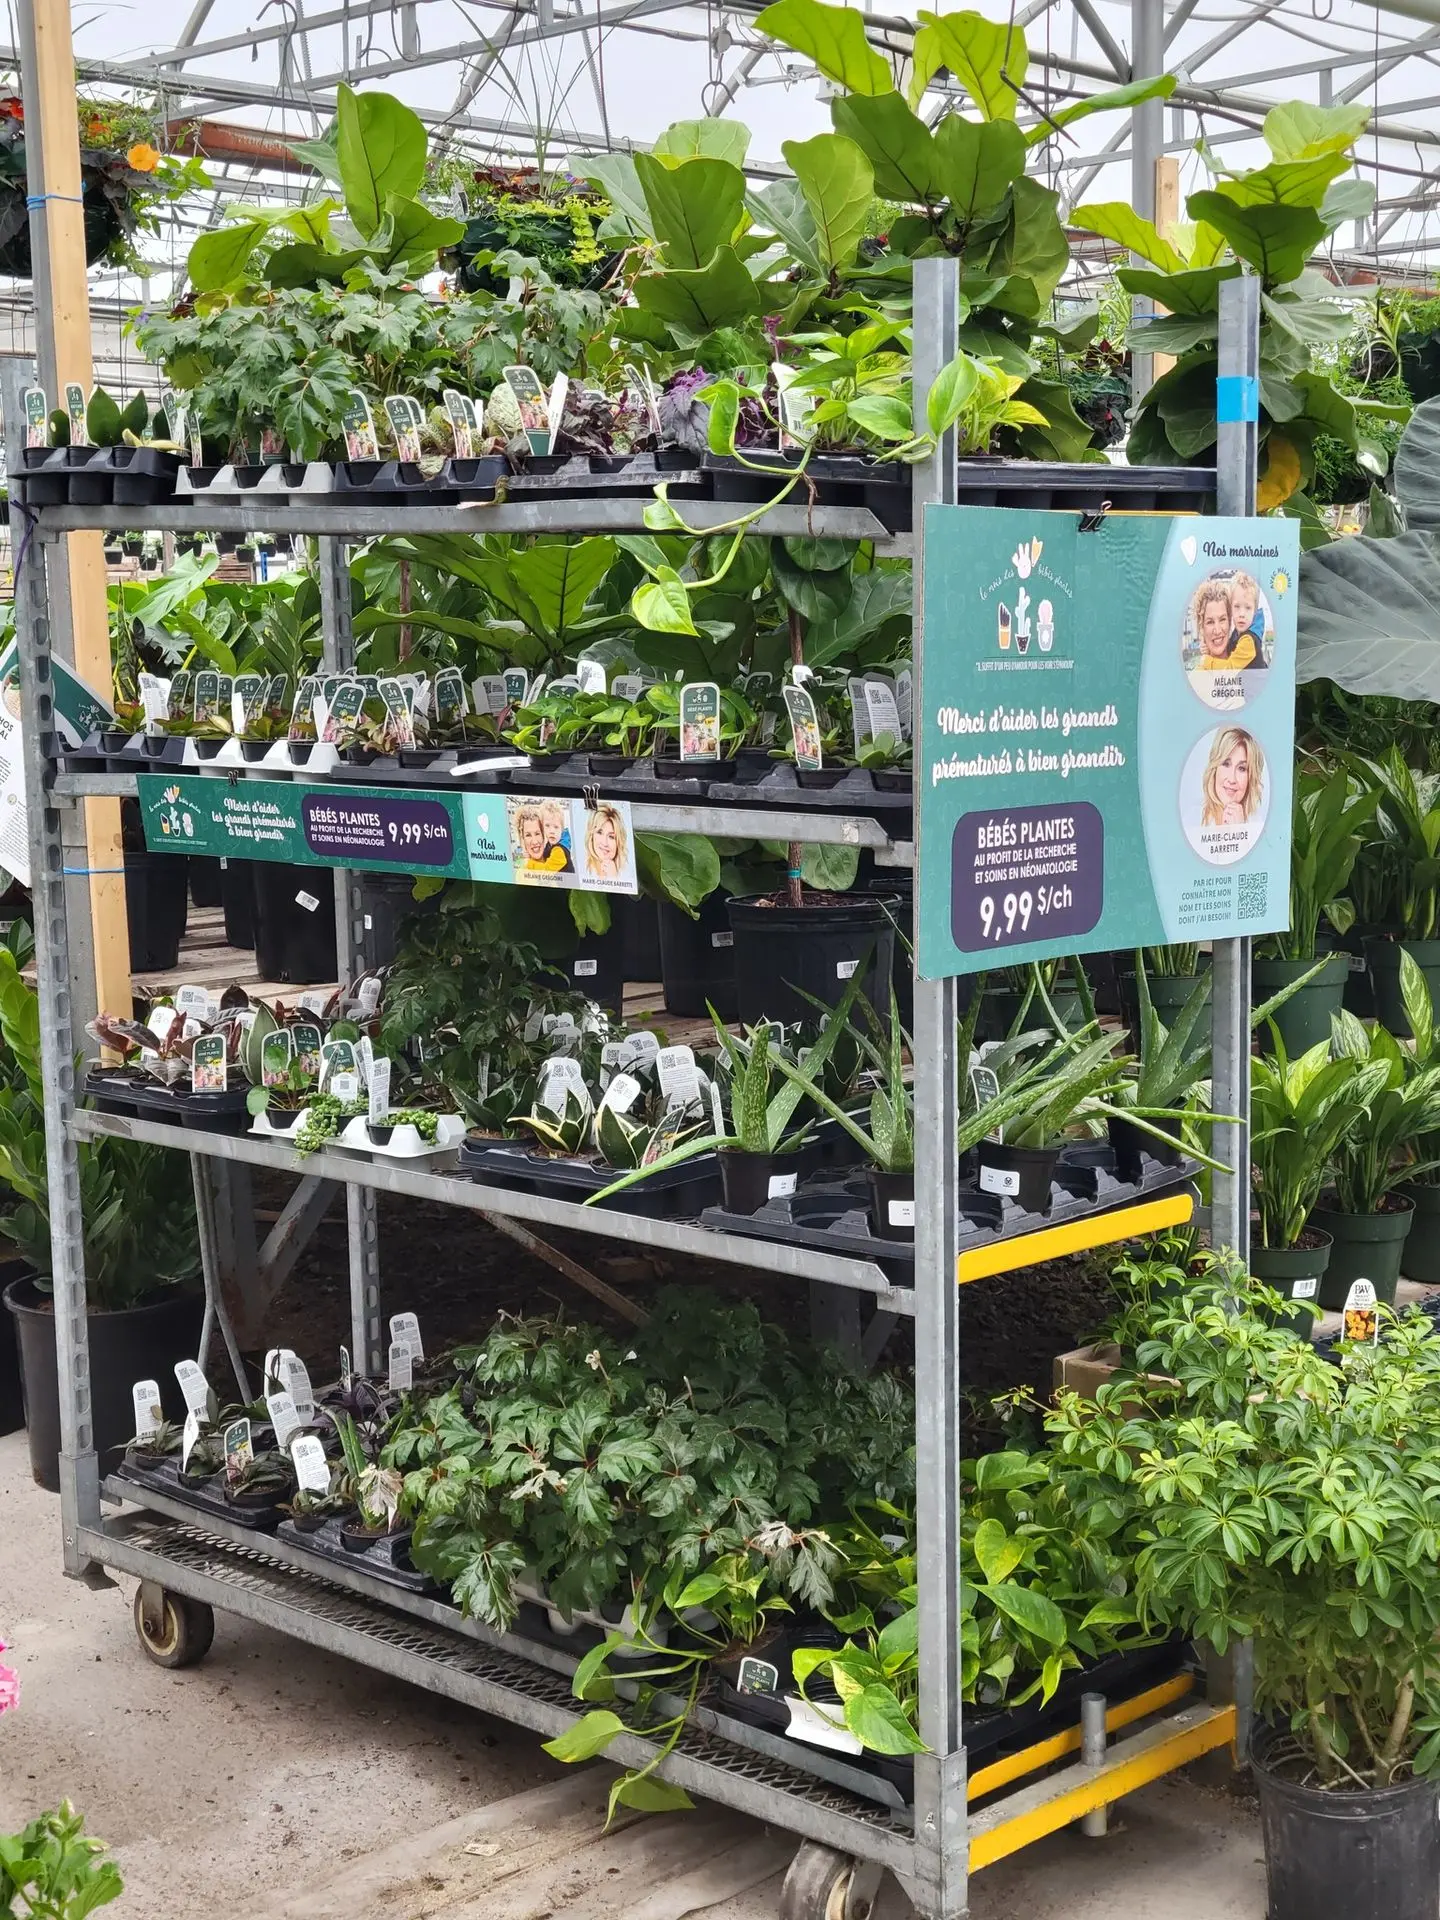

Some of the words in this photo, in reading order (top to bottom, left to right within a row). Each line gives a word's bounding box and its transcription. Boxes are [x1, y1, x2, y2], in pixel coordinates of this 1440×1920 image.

[1203, 541, 1226, 557] Nos
[1230, 545, 1279, 558] marraines
[1214, 674, 1242, 686] MÉLANIE
[1211, 687, 1245, 698] GRÉGOIRE
[937, 707, 986, 735] Merci
[989, 705, 1038, 732] d'aider
[1041, 706, 1059, 729] les
[1062, 705, 1119, 736] grands
[932, 748, 1012, 787] prématurés
[1015, 748, 1026, 773] à
[1028, 749, 1059, 772] bien
[1061, 745, 1126, 778] grandir
[223, 797, 251, 811] Merci
[251, 801, 281, 815] d'aider
[212, 811, 223, 822] les
[225, 813, 251, 827] grands
[252, 815, 296, 829] prématurés
[309, 806, 338, 824] BÉBÉS
[339, 811, 381, 827] PLANTES
[228, 824, 234, 836] à
[235, 826, 253, 838] bien
[254, 828, 285, 842] grandir
[318, 825, 336, 833] PROFIT
[337, 826, 344, 834] DE
[352, 827, 384, 837] RECHERCHE
[388, 822, 421, 845] 9,99
[423, 823, 447, 839] $/ch
[977, 817, 1017, 849] BÉBÉS
[1020, 817, 1075, 844] PLANTES
[1200, 831, 1249, 843] MARIE-CLAUDE
[318, 834, 335, 843] SOINS
[343, 835, 385, 847] NÉONATOLOGIE
[477, 838, 496, 851] Nos
[470, 850, 508, 862] marraines
[974, 853, 985, 867] AU
[986, 850, 1012, 865] PROFIT
[1013, 849, 1023, 862] DE
[1024, 847, 1033, 860] LA
[1034, 843, 1077, 859] RECHERCHE
[1210, 843, 1239, 854] BARRETTE
[975, 871, 983, 885] ET
[984, 869, 1007, 884] SOINS
[1008, 867, 1019, 880] EN
[1020, 859, 1078, 879] NÉONATOLOGIE
[1193, 879, 1205, 887] PAR
[1215, 876, 1232, 886] POUR
[1181, 888, 1216, 900] CONNAÎTRE
[1217, 888, 1232, 897] MON
[980, 890, 1033, 941] 9,99
[1037, 884, 1072, 916] $/ch
[1178, 904, 1194, 913] NOM
[1194, 903, 1202, 911] ET
[1202, 902, 1213, 910] LES
[1213, 900, 1232, 909] SOINS
[1178, 915, 1195, 925] DONT
[1196, 915, 1207, 924] J'AI
